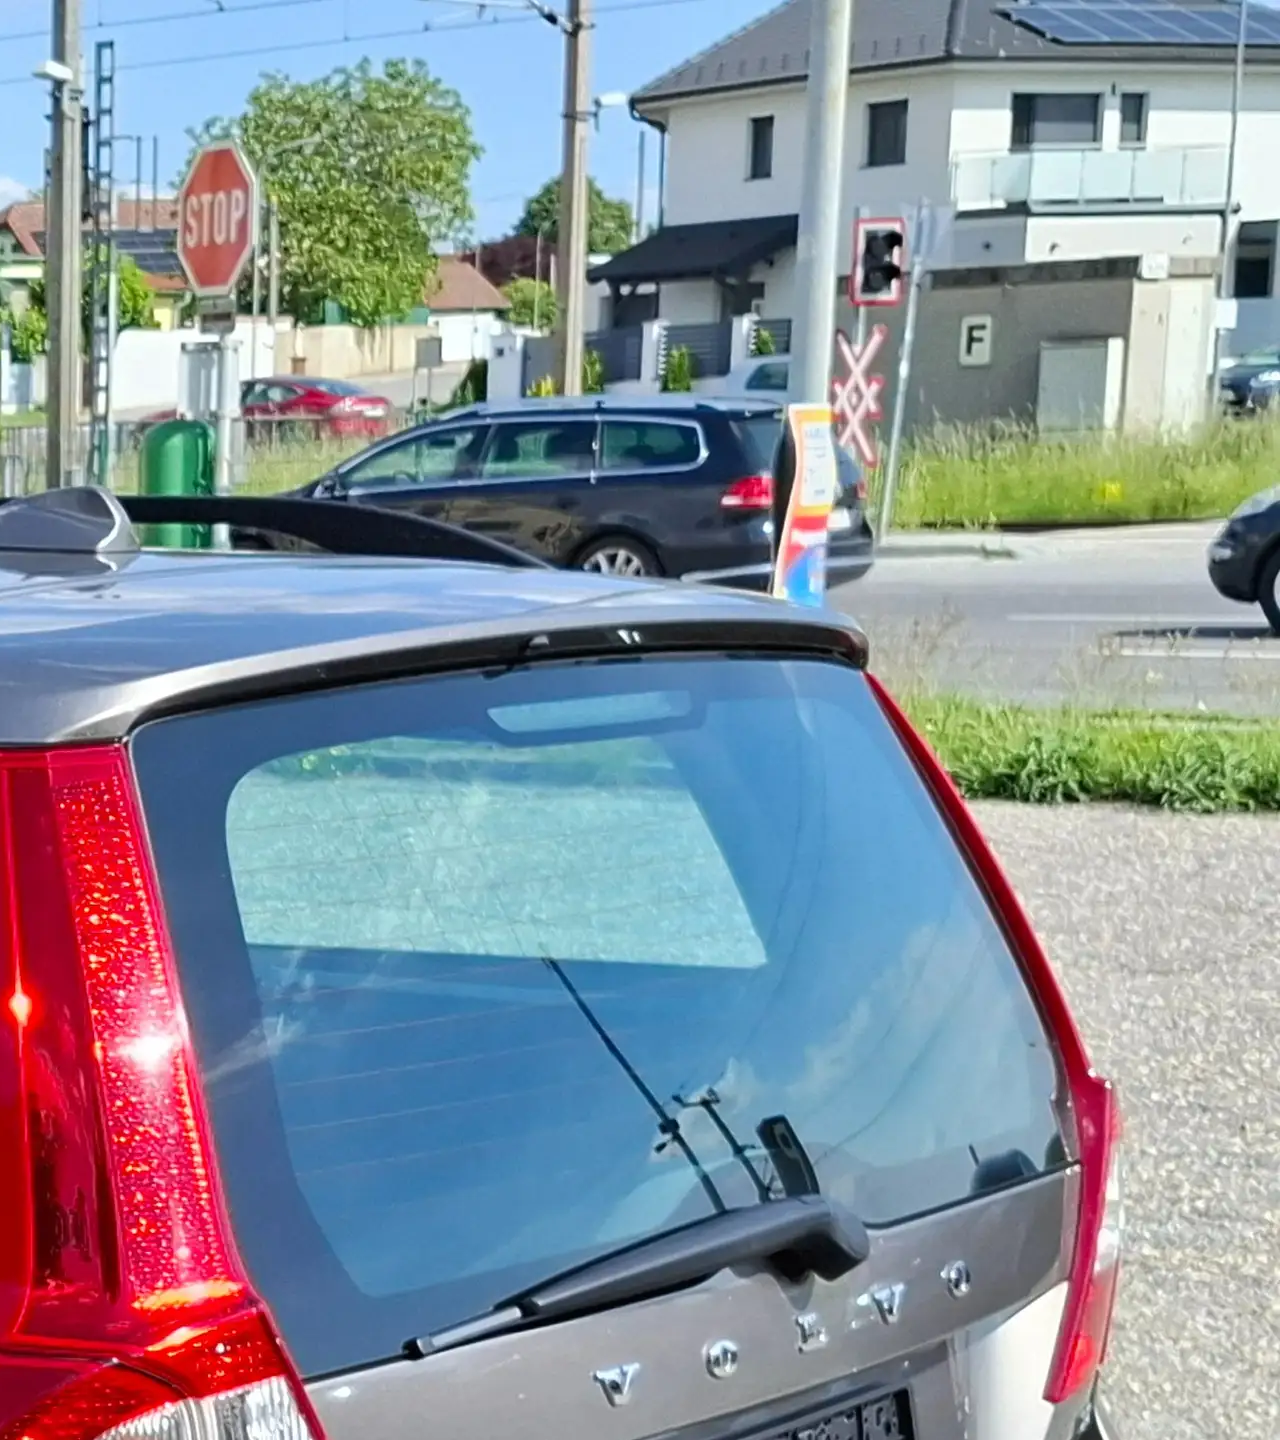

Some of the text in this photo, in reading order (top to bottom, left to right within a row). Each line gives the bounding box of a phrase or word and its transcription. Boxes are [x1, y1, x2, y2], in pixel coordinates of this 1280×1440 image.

[185, 188, 246, 249] STOP
[966, 324, 987, 356] F
[590, 1258, 972, 1408] VOLVO
